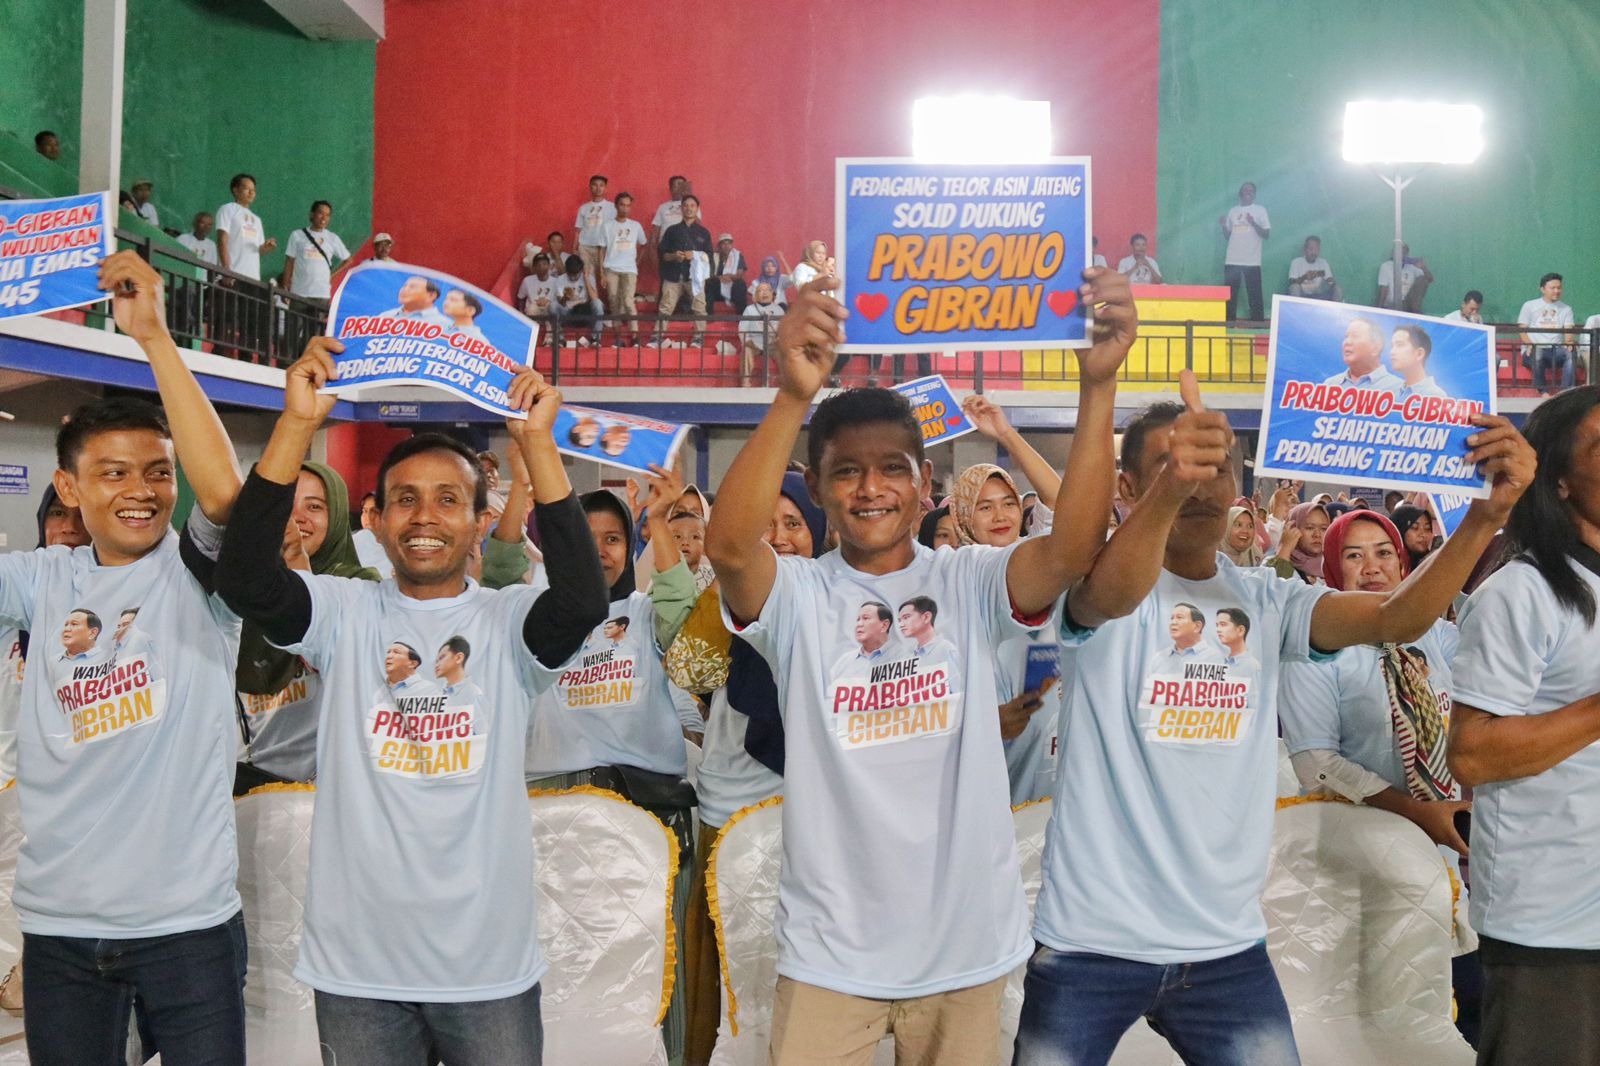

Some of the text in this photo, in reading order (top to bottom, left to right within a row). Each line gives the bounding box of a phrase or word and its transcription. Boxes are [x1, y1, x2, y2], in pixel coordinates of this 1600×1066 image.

[851, 176, 1081, 197] PEDAGANG TELOR ASIN JATENG
[892, 201, 1045, 228] SOLID DUKUNG
[2, 226, 101, 258] WUJUDKAN
[867, 232, 1065, 281] PRABOWO
[30, 247, 100, 278] EMAS
[894, 283, 1044, 335] GIBRAN
[340, 316, 515, 375] PRABOWO-GIBRAN
[364, 337, 491, 378] SEJAHTERAKAN
[337, 356, 421, 380] PEDAGANG
[423, 359, 475, 390] TELOR
[1281, 381, 1484, 426] PRABOWO-GIBRAN
[1312, 416, 1450, 451] SEJAHTERAKAN
[1274, 438, 1374, 471] PEDAGANG
[1377, 449, 1431, 475] TELOR
[559, 660, 633, 686] PRABOWO
[583, 648, 615, 668] WAYAHE
[870, 658, 919, 683] WAYAHE
[1184, 663, 1228, 681] WAYAHE
[396, 696, 447, 714] WAYAHE
[568, 681, 633, 707] GIBRAN
[833, 670, 946, 713] PRABOWO
[1150, 680, 1246, 709] PRABOWO
[848, 701, 948, 744] GIBRAN
[1157, 709, 1241, 739] GIBRAN
